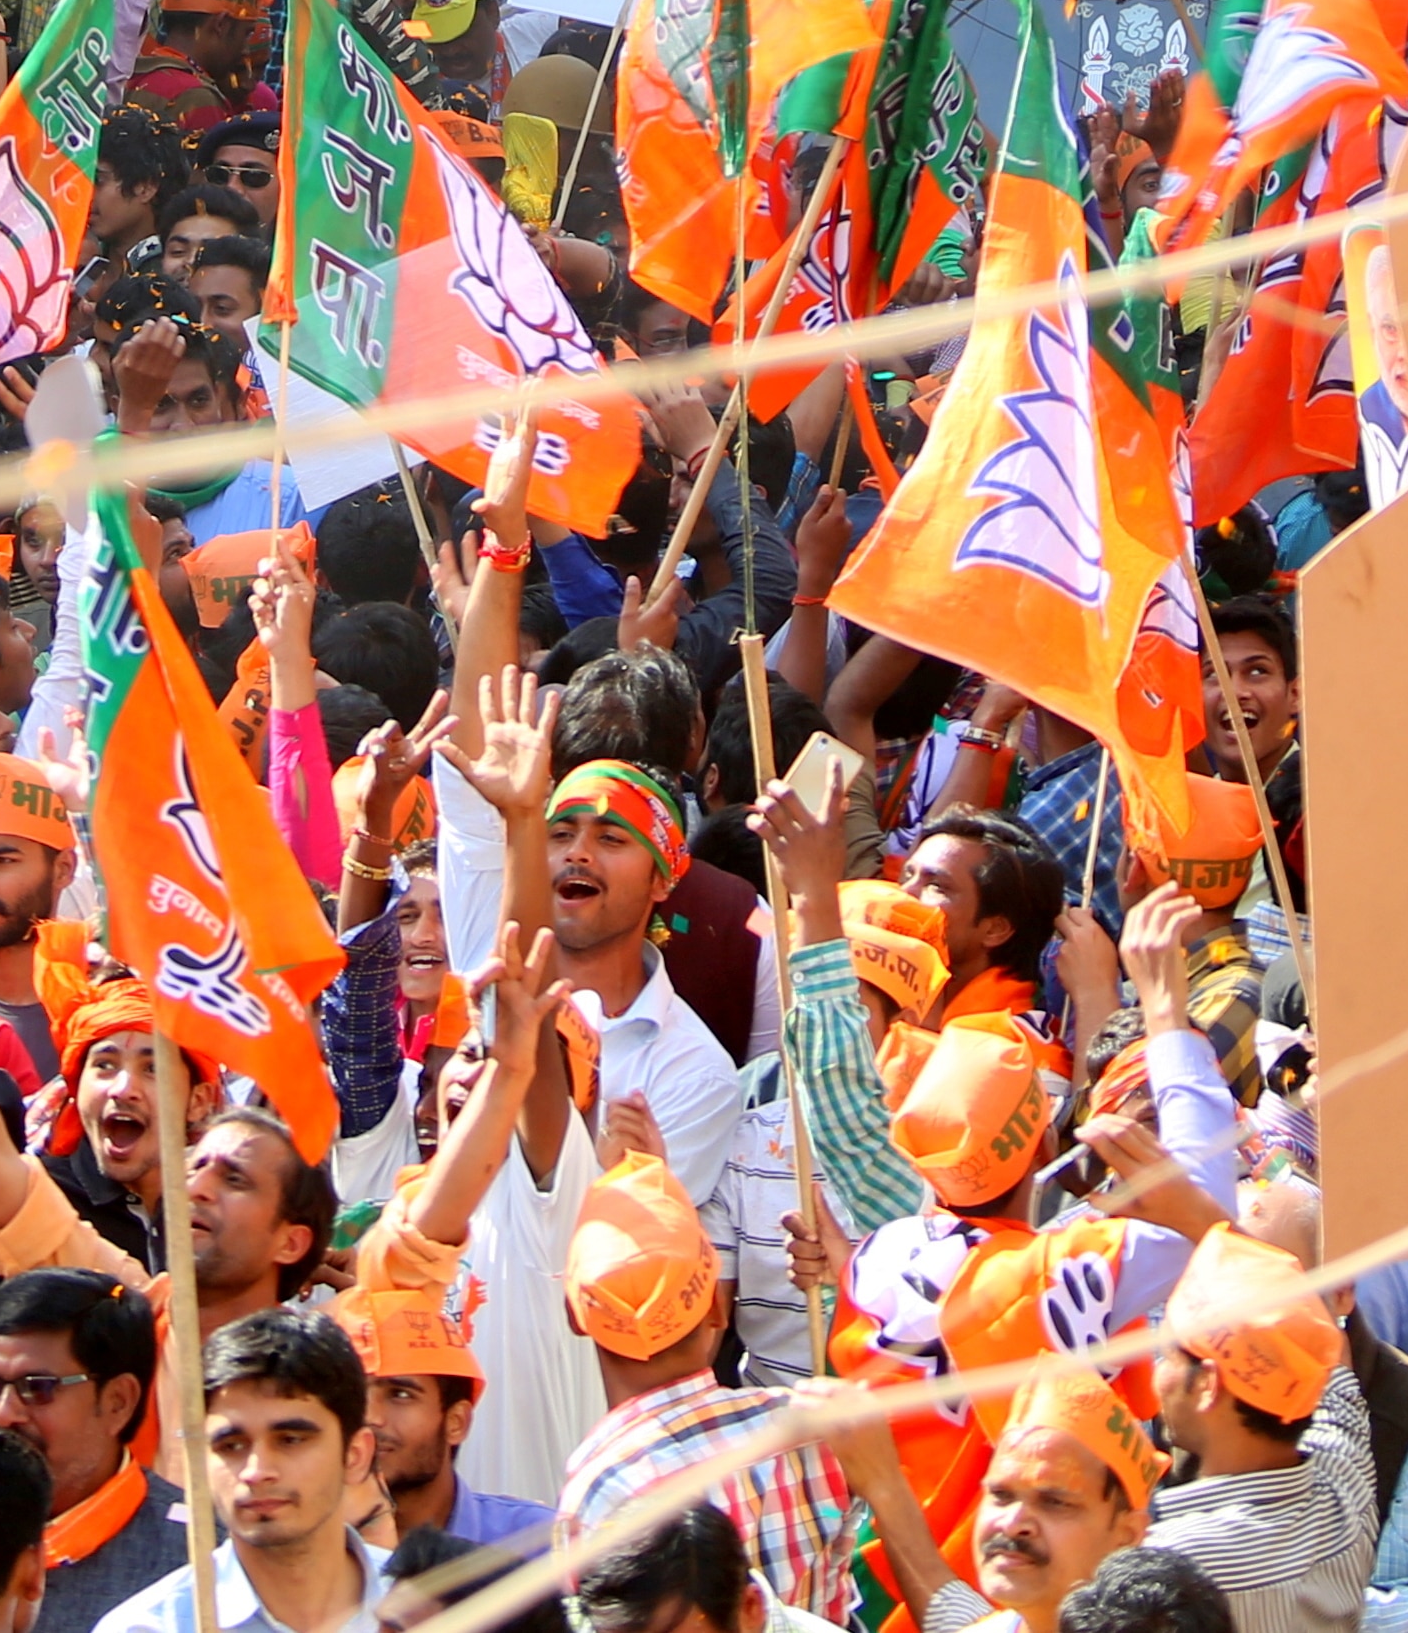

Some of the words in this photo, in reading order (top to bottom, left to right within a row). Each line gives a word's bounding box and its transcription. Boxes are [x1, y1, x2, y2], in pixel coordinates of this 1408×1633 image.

[336, 22, 411, 145] भा.
[321, 123, 396, 246] ज.
[309, 237, 391, 367] पा.
[147, 873, 227, 942] चुनाव
